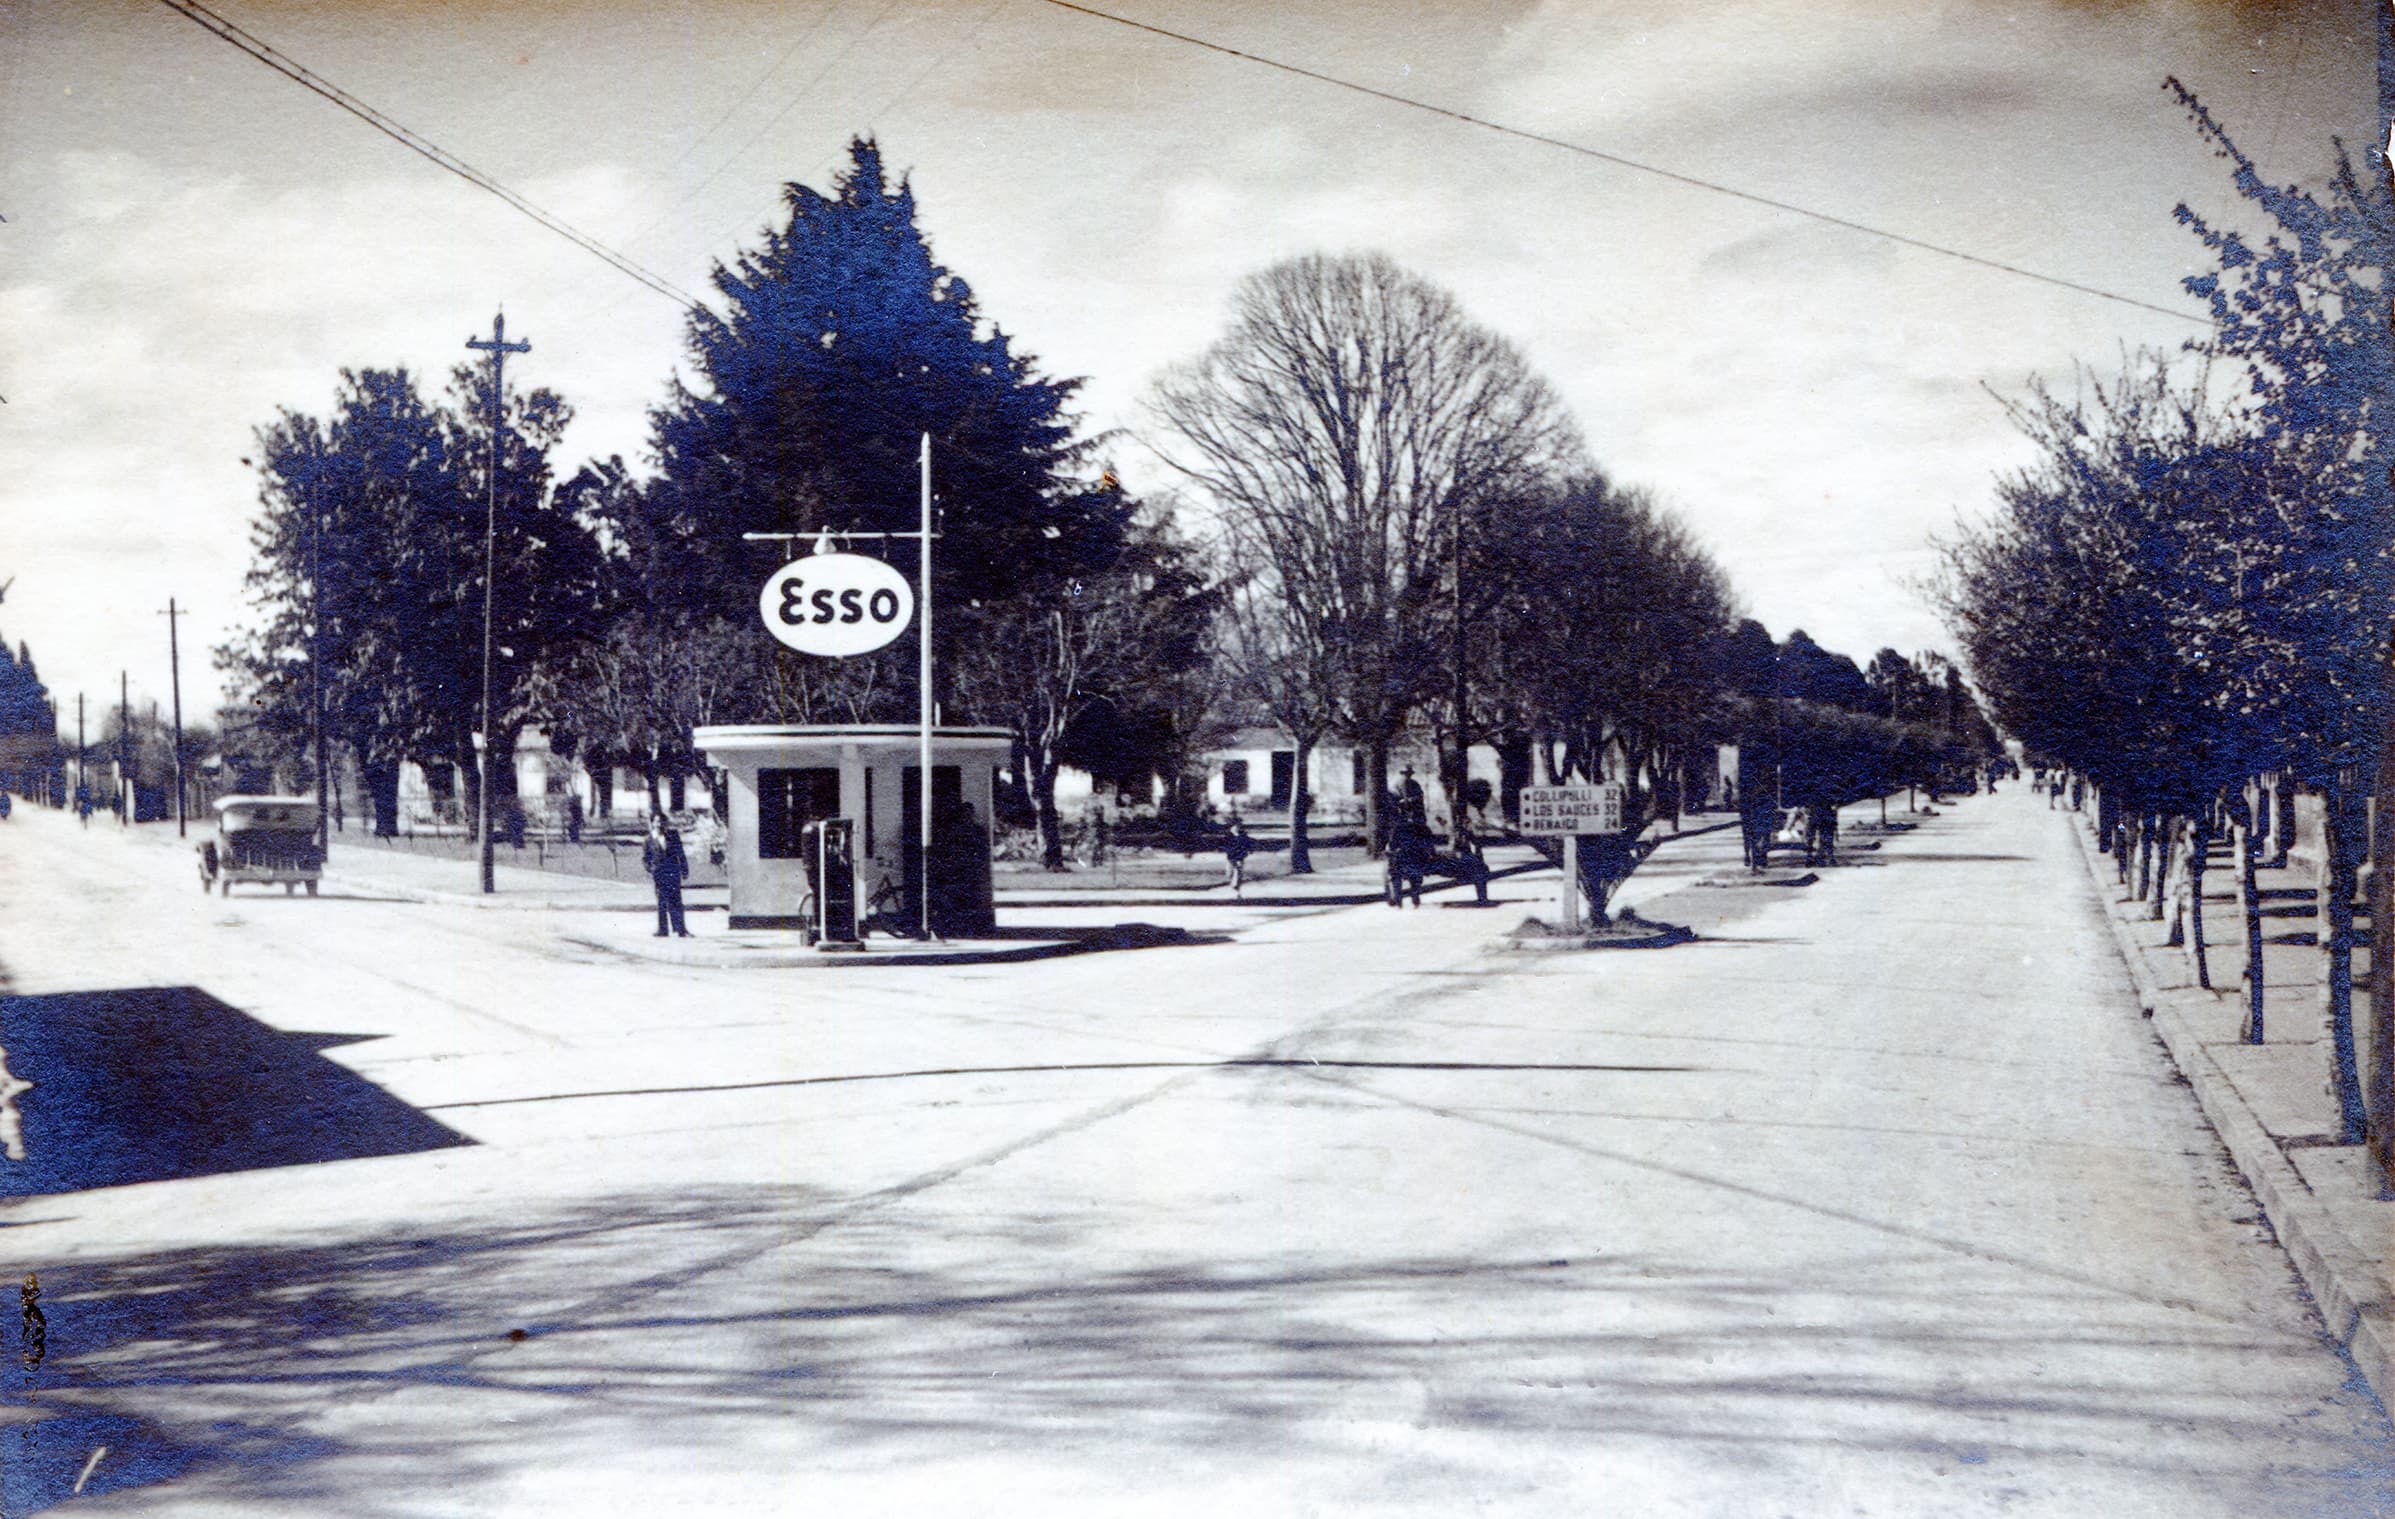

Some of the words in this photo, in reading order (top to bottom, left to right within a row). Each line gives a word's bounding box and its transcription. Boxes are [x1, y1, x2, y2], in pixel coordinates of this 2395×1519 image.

[779, 577, 899, 625] Esso
[1604, 789, 1618, 801] 32
[1533, 804, 1553, 816] LOS
[1558, 804, 1600, 816] SAUCES
[1604, 803, 1618, 815] 32
[1604, 818, 1618, 829] 24
